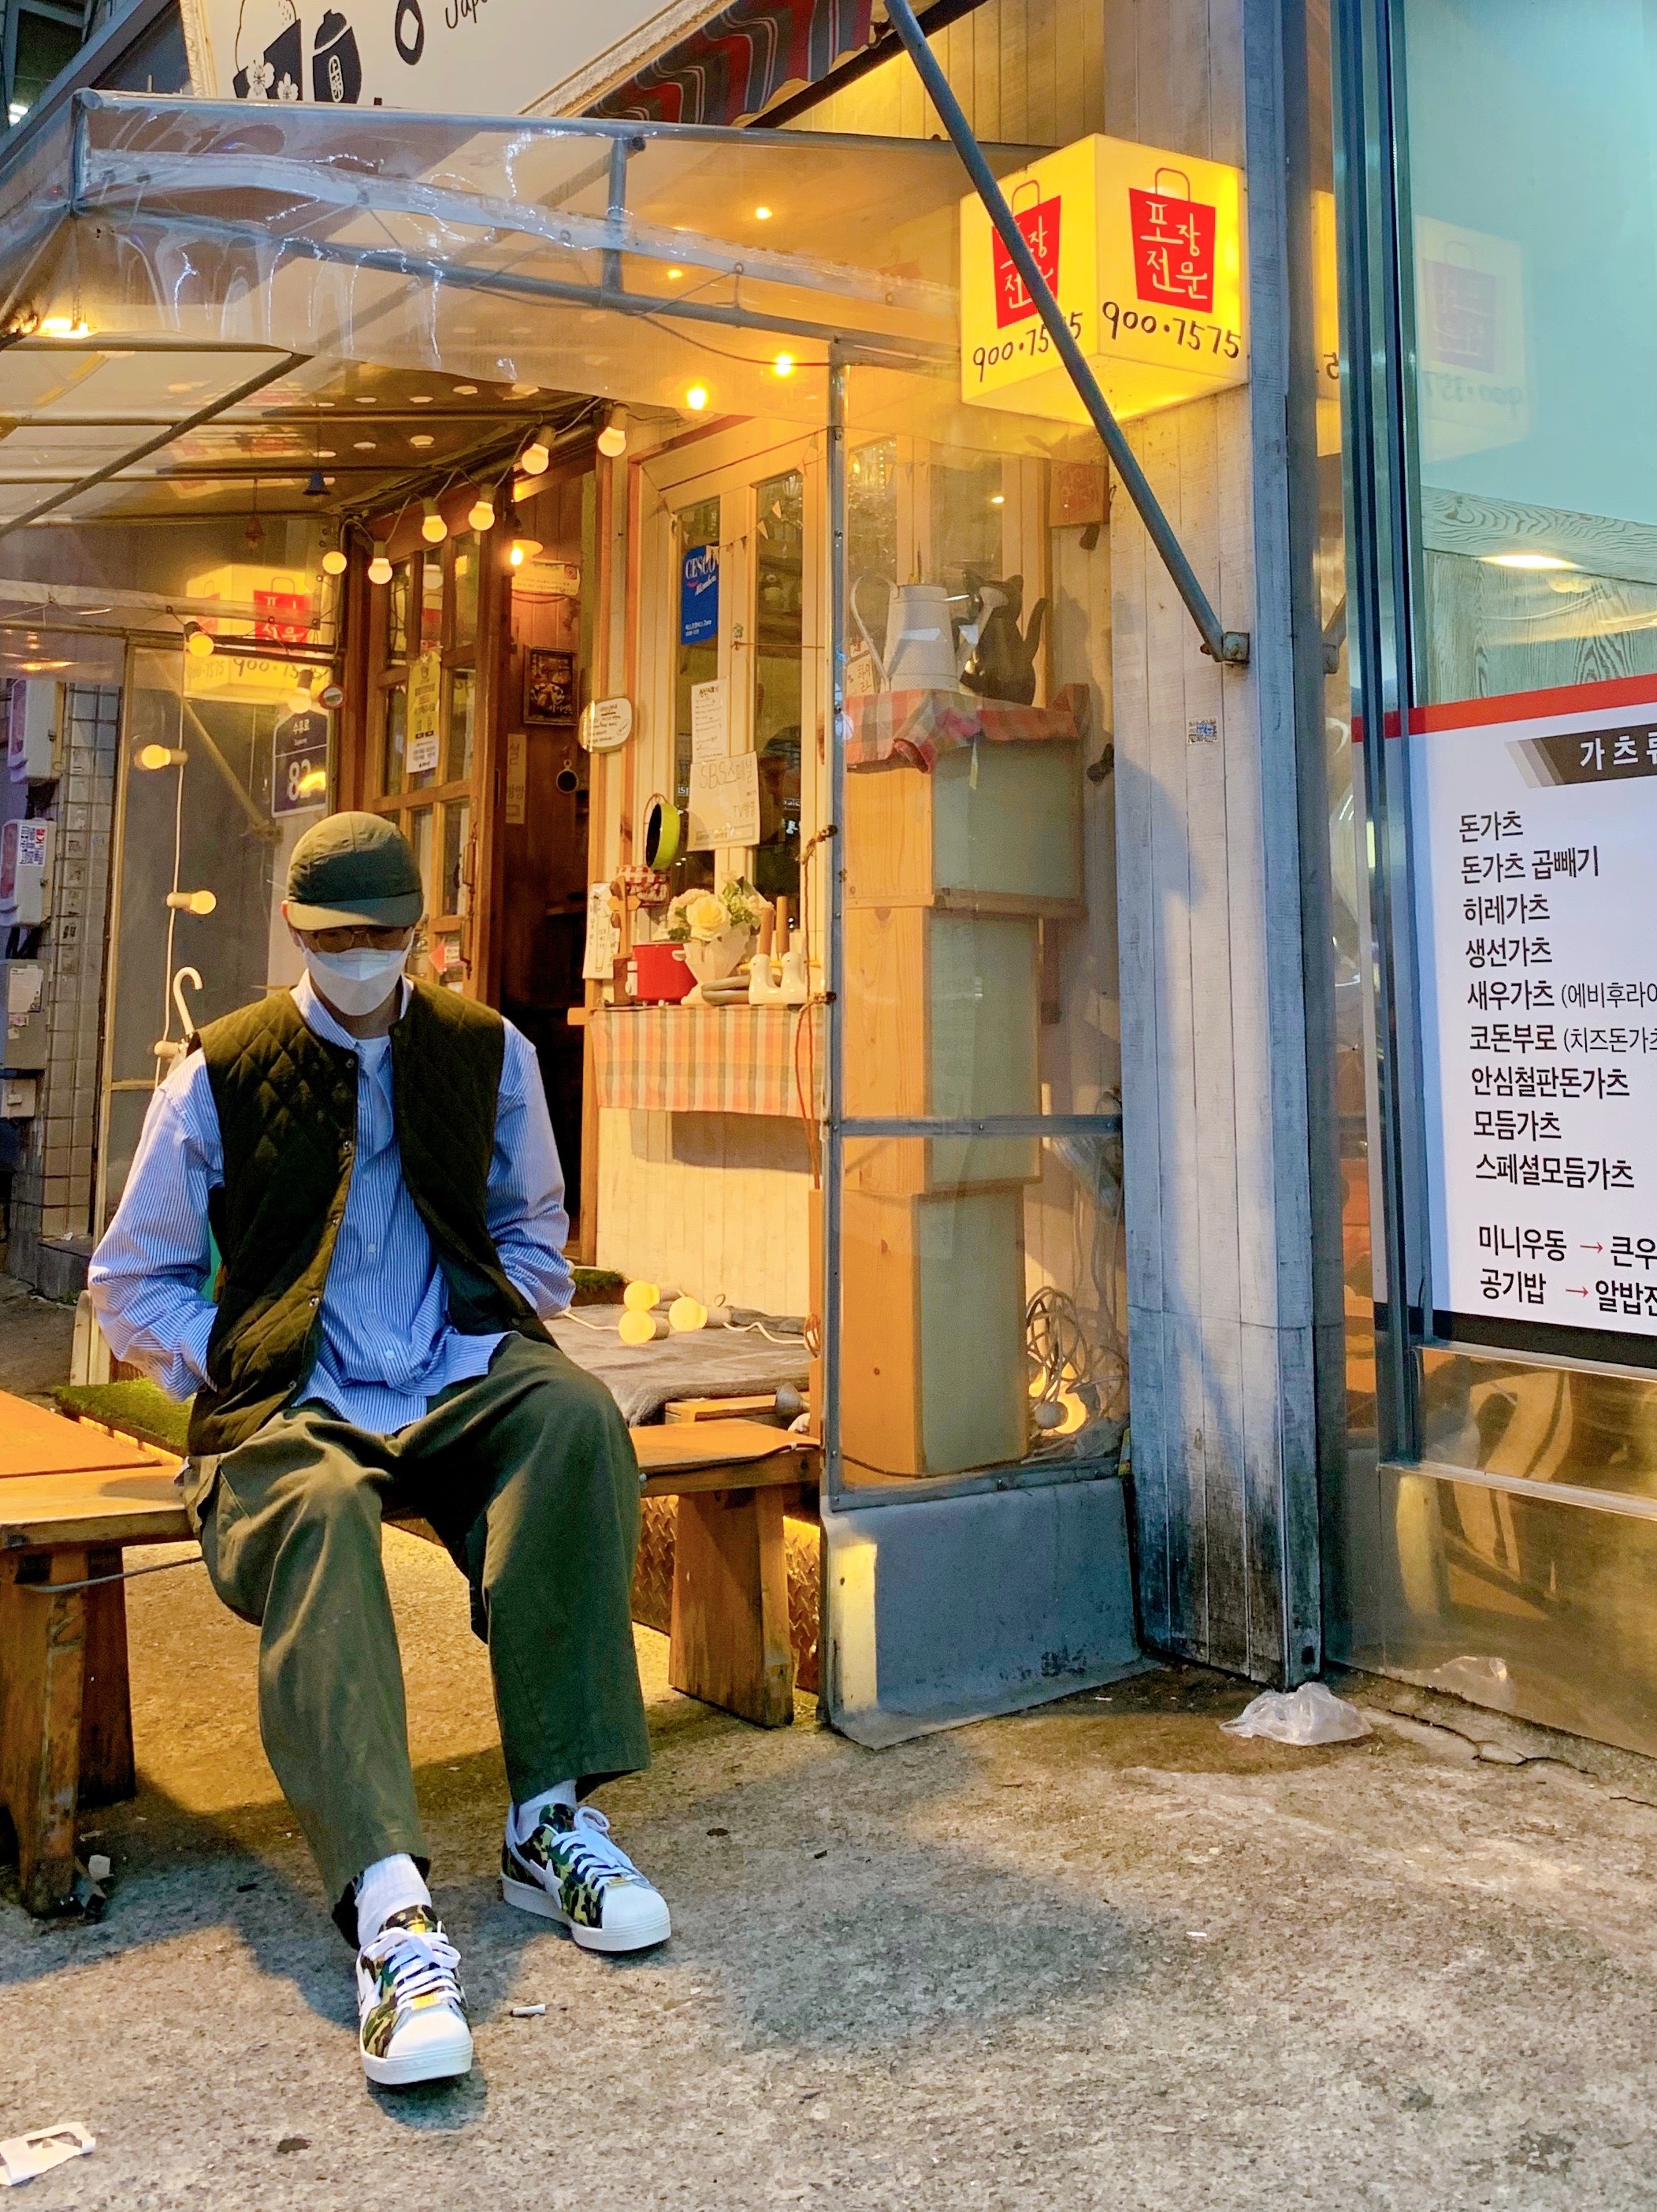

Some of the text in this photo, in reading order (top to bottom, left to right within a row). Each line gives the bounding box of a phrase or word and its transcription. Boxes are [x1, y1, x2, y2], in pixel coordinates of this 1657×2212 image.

[445, 0, 488, 29] Jap
[1140, 200, 1201, 257] 포장
[1146, 246, 1208, 299] 전문
[1459, 810, 1524, 843] 돈가츠
[1461, 845, 1599, 885] 돈가츠 곱빼기
[1463, 894, 1551, 926] 히레가츠
[1466, 936, 1553, 968] 생선가츠
[1467, 980, 1555, 1011] 새우가츠
[1469, 1023, 1558, 1055] 코돈부로
[1471, 1065, 1630, 1100] 안심철판돈가츠
[1474, 1110, 1562, 1143] 모듬가츠
[1476, 1153, 1635, 1191] 스페셜모듬가츠
[1479, 1225, 1567, 1262] 미니우동
[1481, 1268, 1547, 1305] 공기밥
